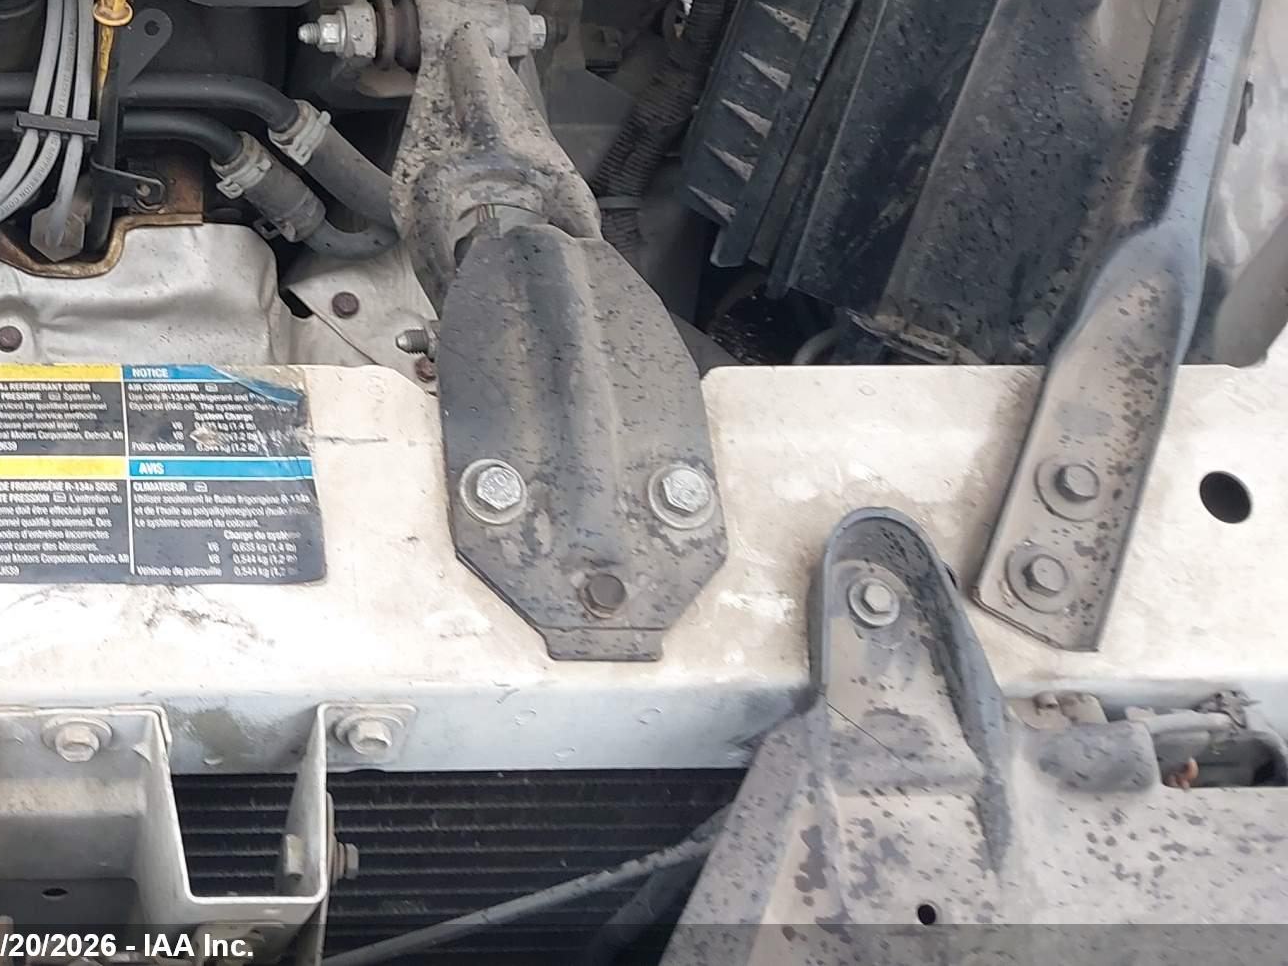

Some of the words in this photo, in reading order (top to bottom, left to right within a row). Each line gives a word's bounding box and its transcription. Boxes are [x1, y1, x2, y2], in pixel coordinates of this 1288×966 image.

[132, 368, 168, 378] NOTICE
[64, 383, 90, 392] UNDER
[128, 384, 142, 392] AIR
[143, 384, 199, 392] CONDITIONING
[139, 462, 165, 474] AVIS
[9, 494, 50, 503] PRESSION
